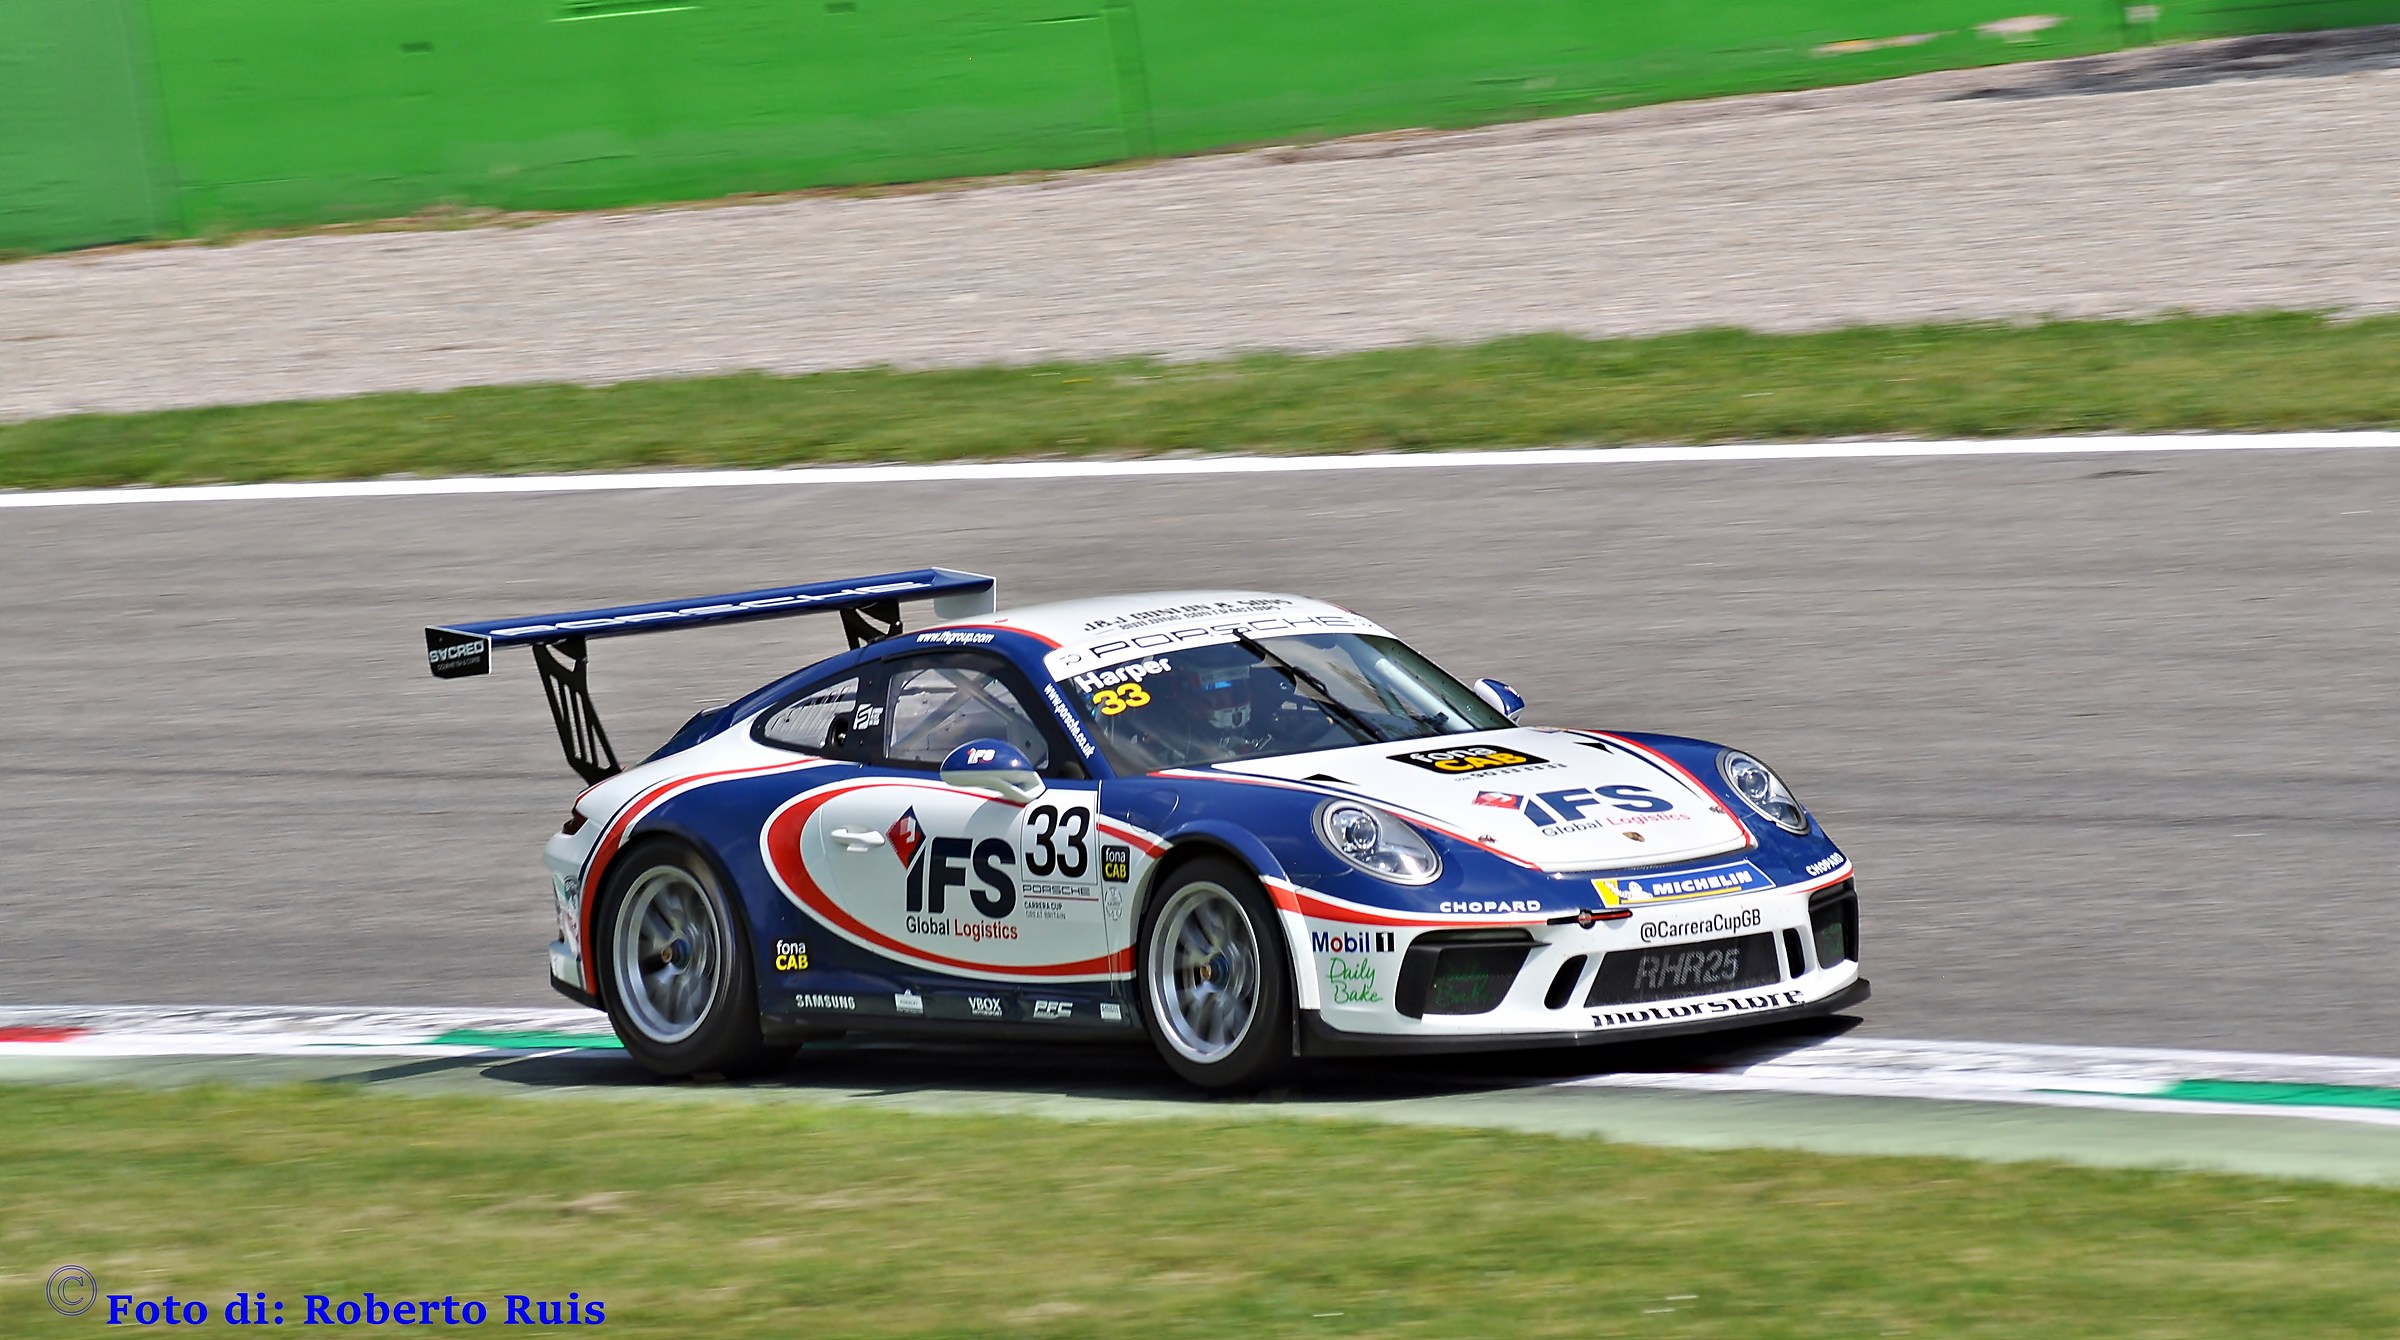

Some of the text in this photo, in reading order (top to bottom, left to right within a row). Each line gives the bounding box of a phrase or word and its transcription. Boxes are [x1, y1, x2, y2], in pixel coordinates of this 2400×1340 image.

[490, 581, 932, 636] PORSCHE
[1089, 616, 1357, 659] PORSCHE
[1074, 657, 1172, 693] Harper
[1093, 683, 1151, 716] 33
[1044, 683, 1096, 759] www.porsche.co.uk
[1410, 746, 1498, 763] fona
[1434, 753, 1527, 772] CAB
[1524, 784, 1674, 827] IFS
[1542, 812, 1692, 836] Global Logistics
[1024, 804, 1091, 879] 33
[1105, 847, 1126, 863] fona
[1805, 852, 1845, 877] CHOPARD
[906, 836, 1017, 919] IFS
[1105, 863, 1127, 879] CAB
[1652, 870, 1753, 896] MICHELIN
[1022, 884, 1091, 896] PORSCHE
[1024, 901, 1063, 910] CARRERA CUP
[1439, 900, 1541, 913] CHOPARD
[906, 915, 1018, 942] Global Logistics
[1640, 908, 1762, 943] @CarreraCupGB
[776, 939, 806, 956] fona
[1312, 931, 1370, 953] Mobil
[775, 955, 809, 971] CAB
[1326, 957, 1376, 989] Daily
[795, 994, 856, 1010] SAMSUNG
[968, 997, 1001, 1011] VBOX
[1333, 981, 1384, 1004] Bake
[1591, 989, 1806, 1029] motorstore
